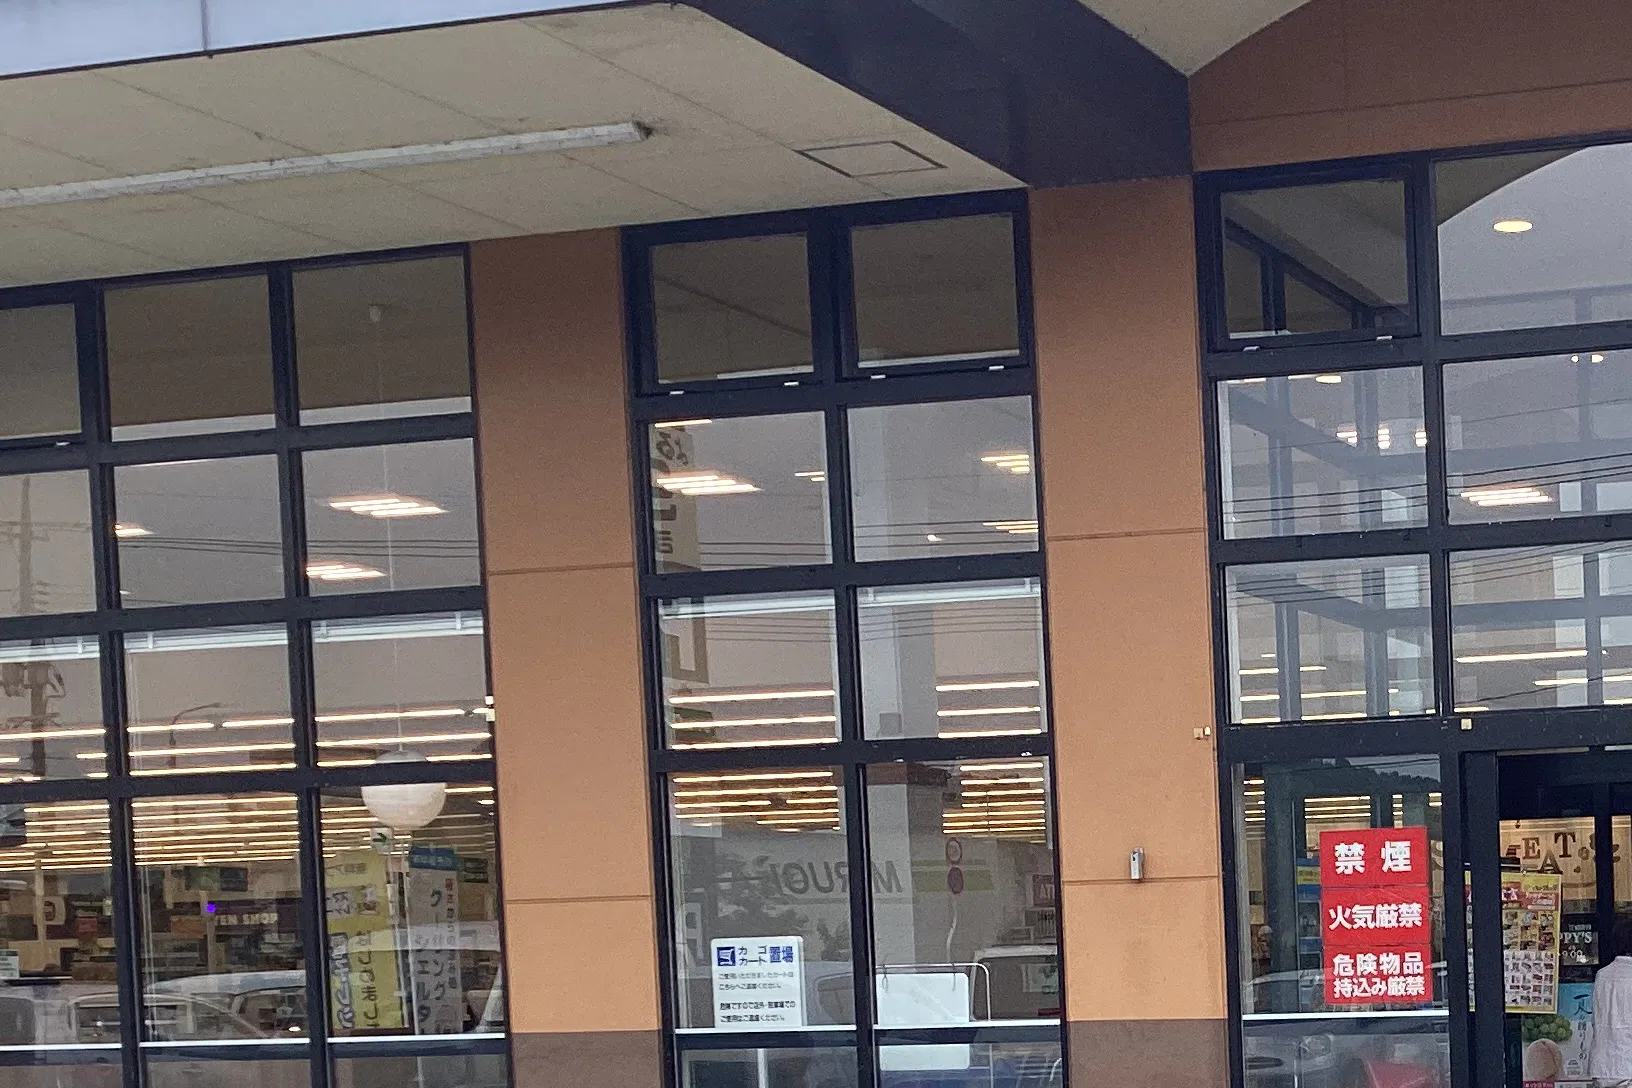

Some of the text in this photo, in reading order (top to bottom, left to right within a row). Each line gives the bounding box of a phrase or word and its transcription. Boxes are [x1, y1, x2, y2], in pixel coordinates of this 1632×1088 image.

[1334, 840, 1412, 874] 禁煙
[1328, 902, 1422, 931] 火気厳禁
[1332, 951, 1425, 976] 危険物品
[1333, 976, 1426, 999] 持込み厳禁
